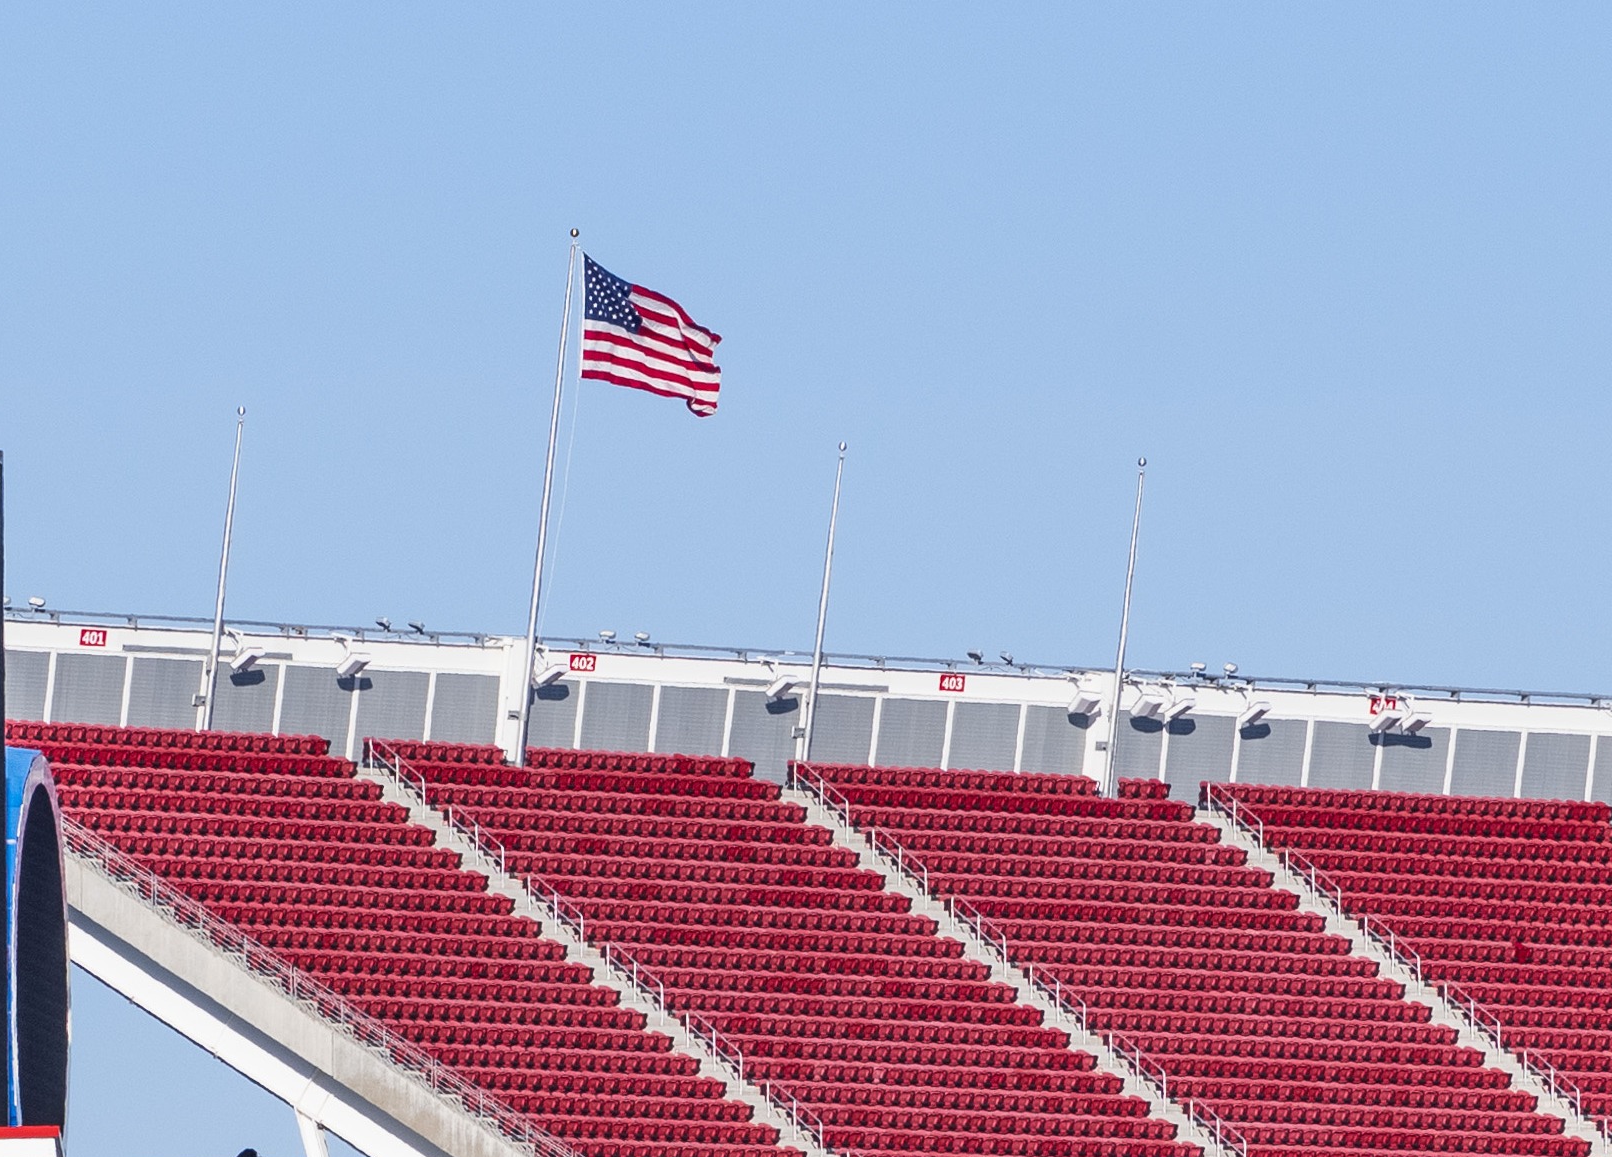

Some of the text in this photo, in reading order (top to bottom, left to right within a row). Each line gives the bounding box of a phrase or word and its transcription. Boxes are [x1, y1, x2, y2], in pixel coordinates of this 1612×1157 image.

[81, 631, 105, 645] 401
[571, 656, 594, 670] 402
[941, 676, 963, 690] 403
